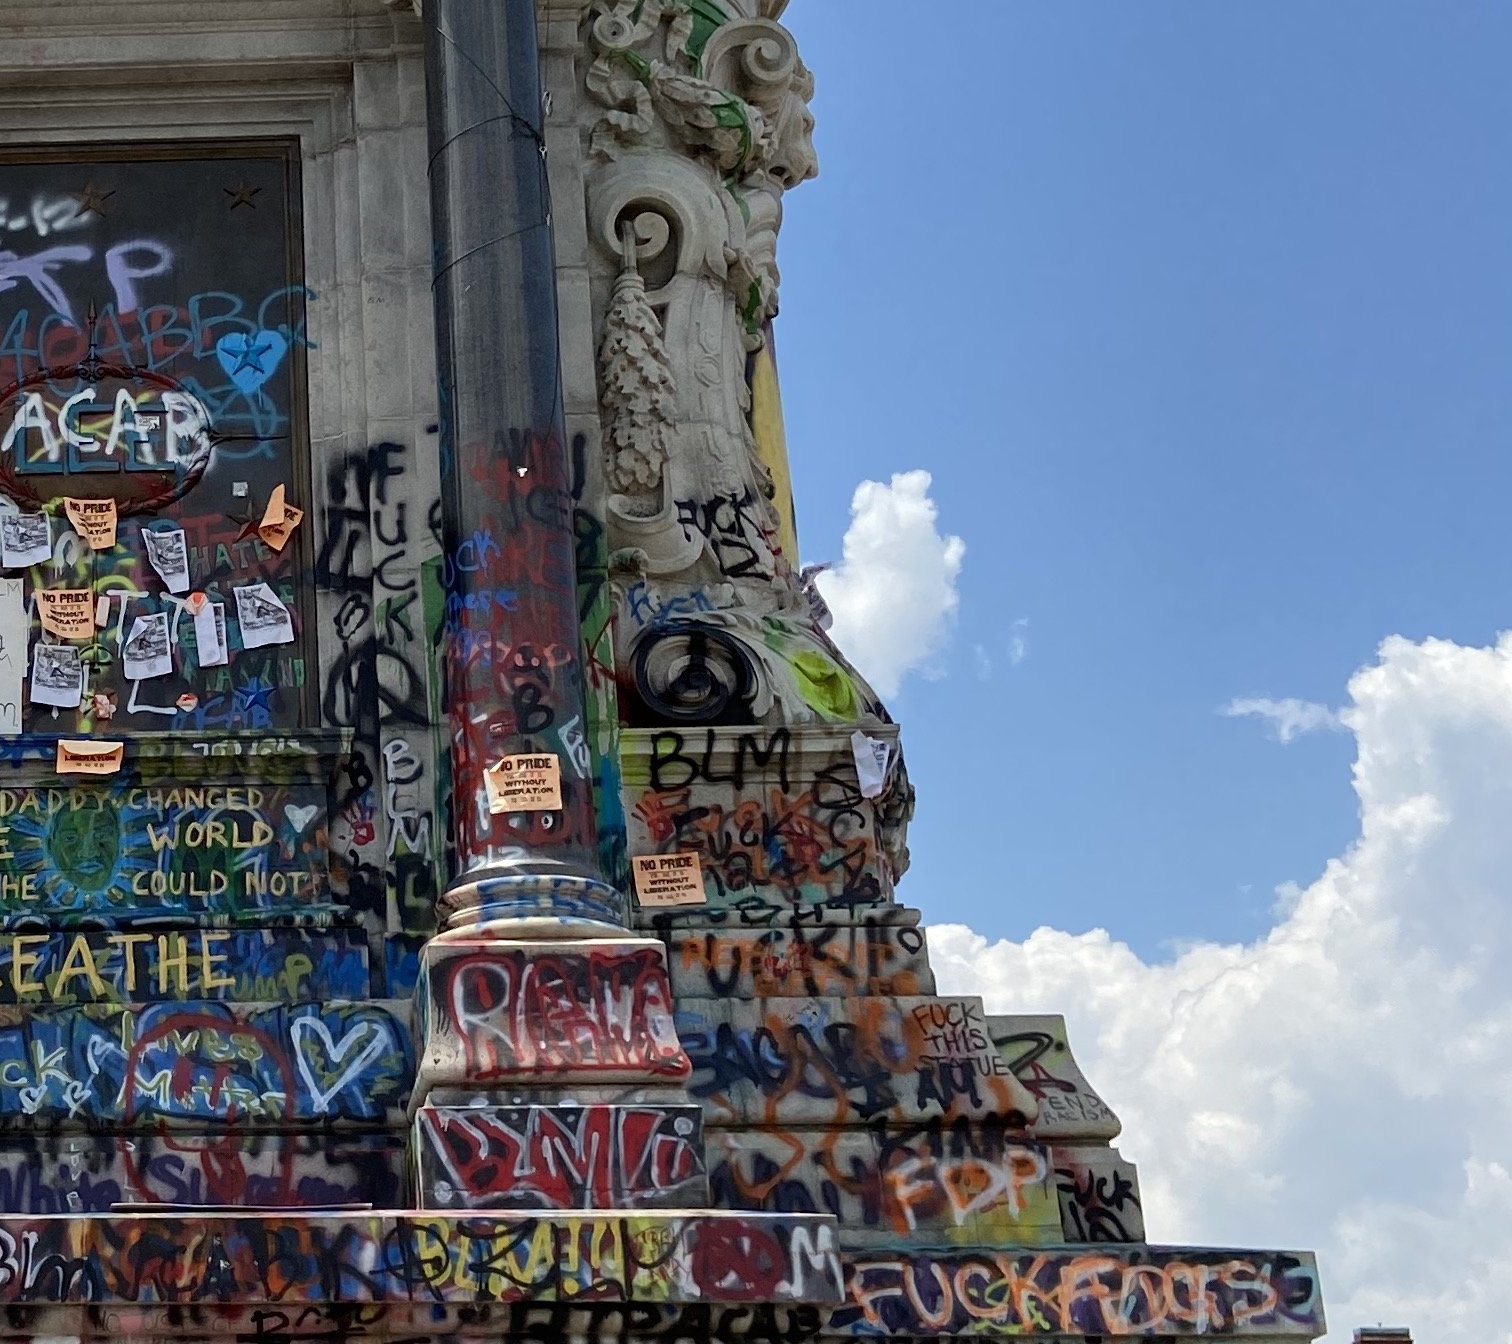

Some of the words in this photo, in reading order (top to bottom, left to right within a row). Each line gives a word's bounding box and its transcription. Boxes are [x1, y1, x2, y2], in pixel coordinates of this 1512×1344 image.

[0, 388, 212, 464] ACAB
[84, 502, 113, 513] PRIDE
[42, 592, 56, 603] NO
[60, 592, 90, 603] PRIDE
[517, 758, 553, 771] PRIDE
[650, 727, 791, 794] BLM
[504, 778, 547, 787] WITHOUT
[128, 786, 265, 811] CHANGED
[498, 786, 554, 797] LIBERATION
[146, 822, 273, 851] WORLD
[640, 859, 656, 871] NO
[659, 857, 693, 870] PRIDE
[0, 873, 41, 901] HE
[131, 869, 228, 897] COULD
[245, 870, 310, 896] NOT
[643, 884, 697, 894] LIBERATION
[649, 876, 689, 886] WITHOUT
[912, 1003, 983, 1034] FUCK
[924, 1028, 988, 1053] THIS
[916, 1056, 1011, 1076] STATUE
[1048, 1093, 1102, 1110] END
[1044, 1108, 1116, 1125] RACISM
